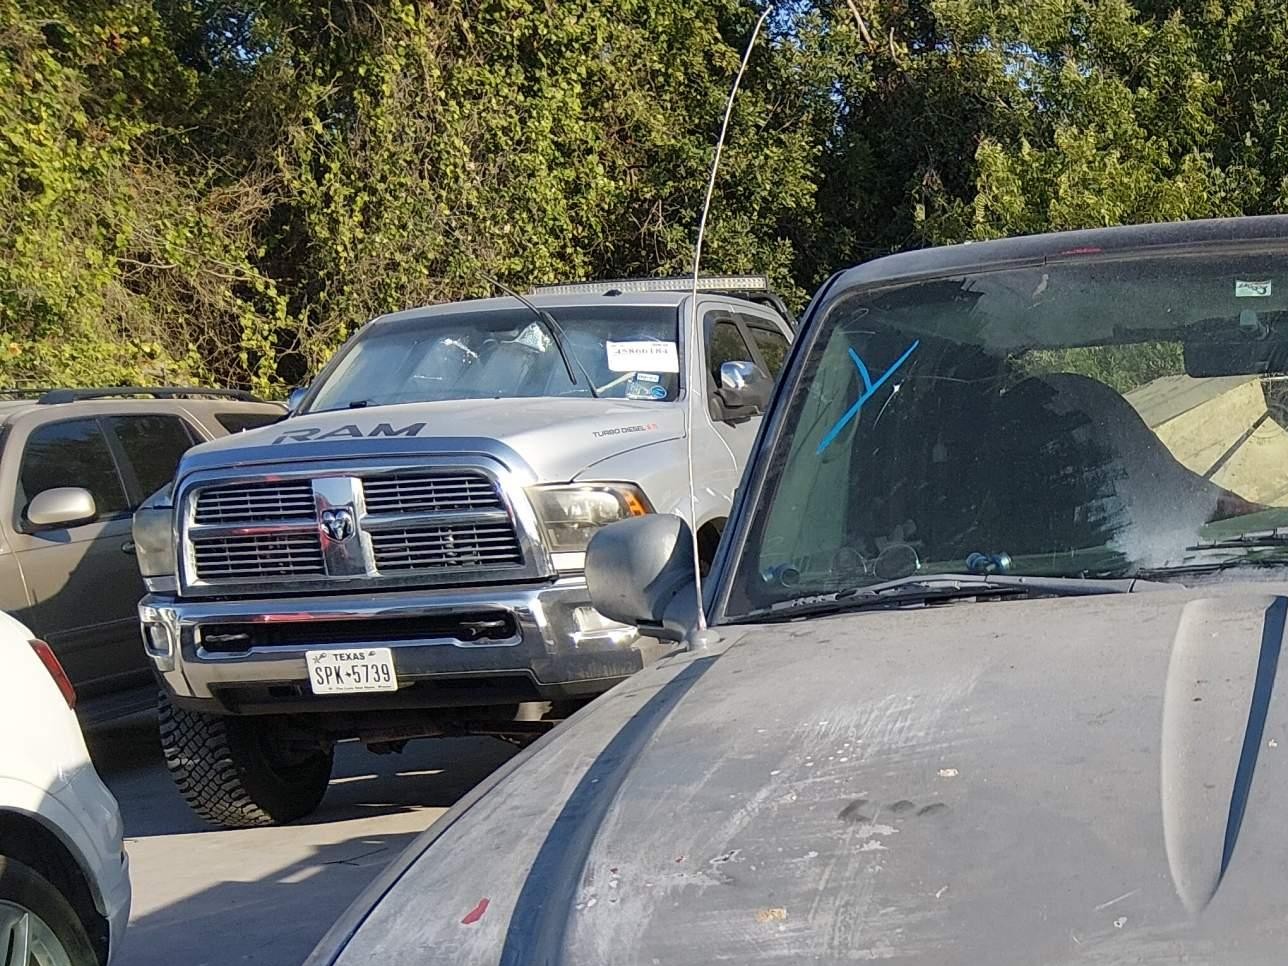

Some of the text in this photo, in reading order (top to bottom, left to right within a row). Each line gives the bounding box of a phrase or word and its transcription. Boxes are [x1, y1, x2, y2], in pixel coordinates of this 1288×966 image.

[271, 422, 428, 445] RAM
[592, 428, 620, 438] TURBO
[332, 652, 366, 662] TEXAS
